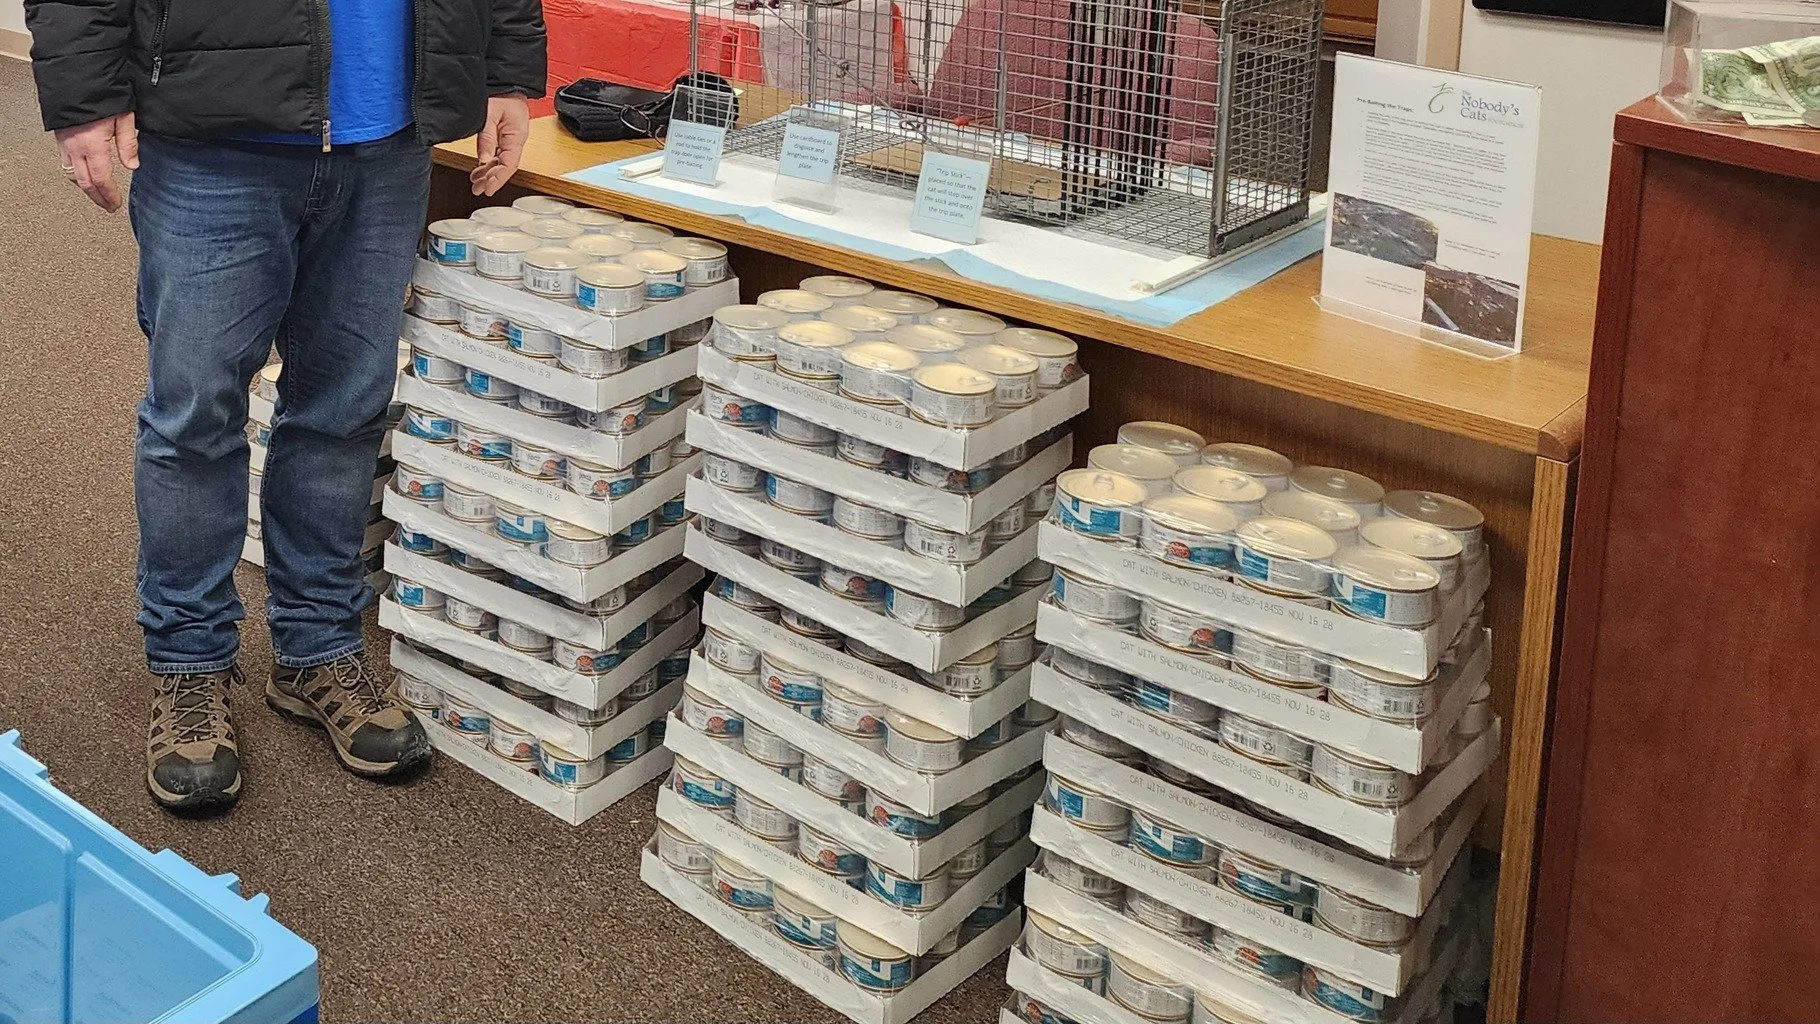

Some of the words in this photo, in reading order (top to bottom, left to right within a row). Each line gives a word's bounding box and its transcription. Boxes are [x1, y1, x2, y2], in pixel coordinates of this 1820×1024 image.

[1460, 95, 1520, 116] Nobody's
[1460, 107, 1487, 122] Cats
[1289, 610, 1304, 622] NOV
